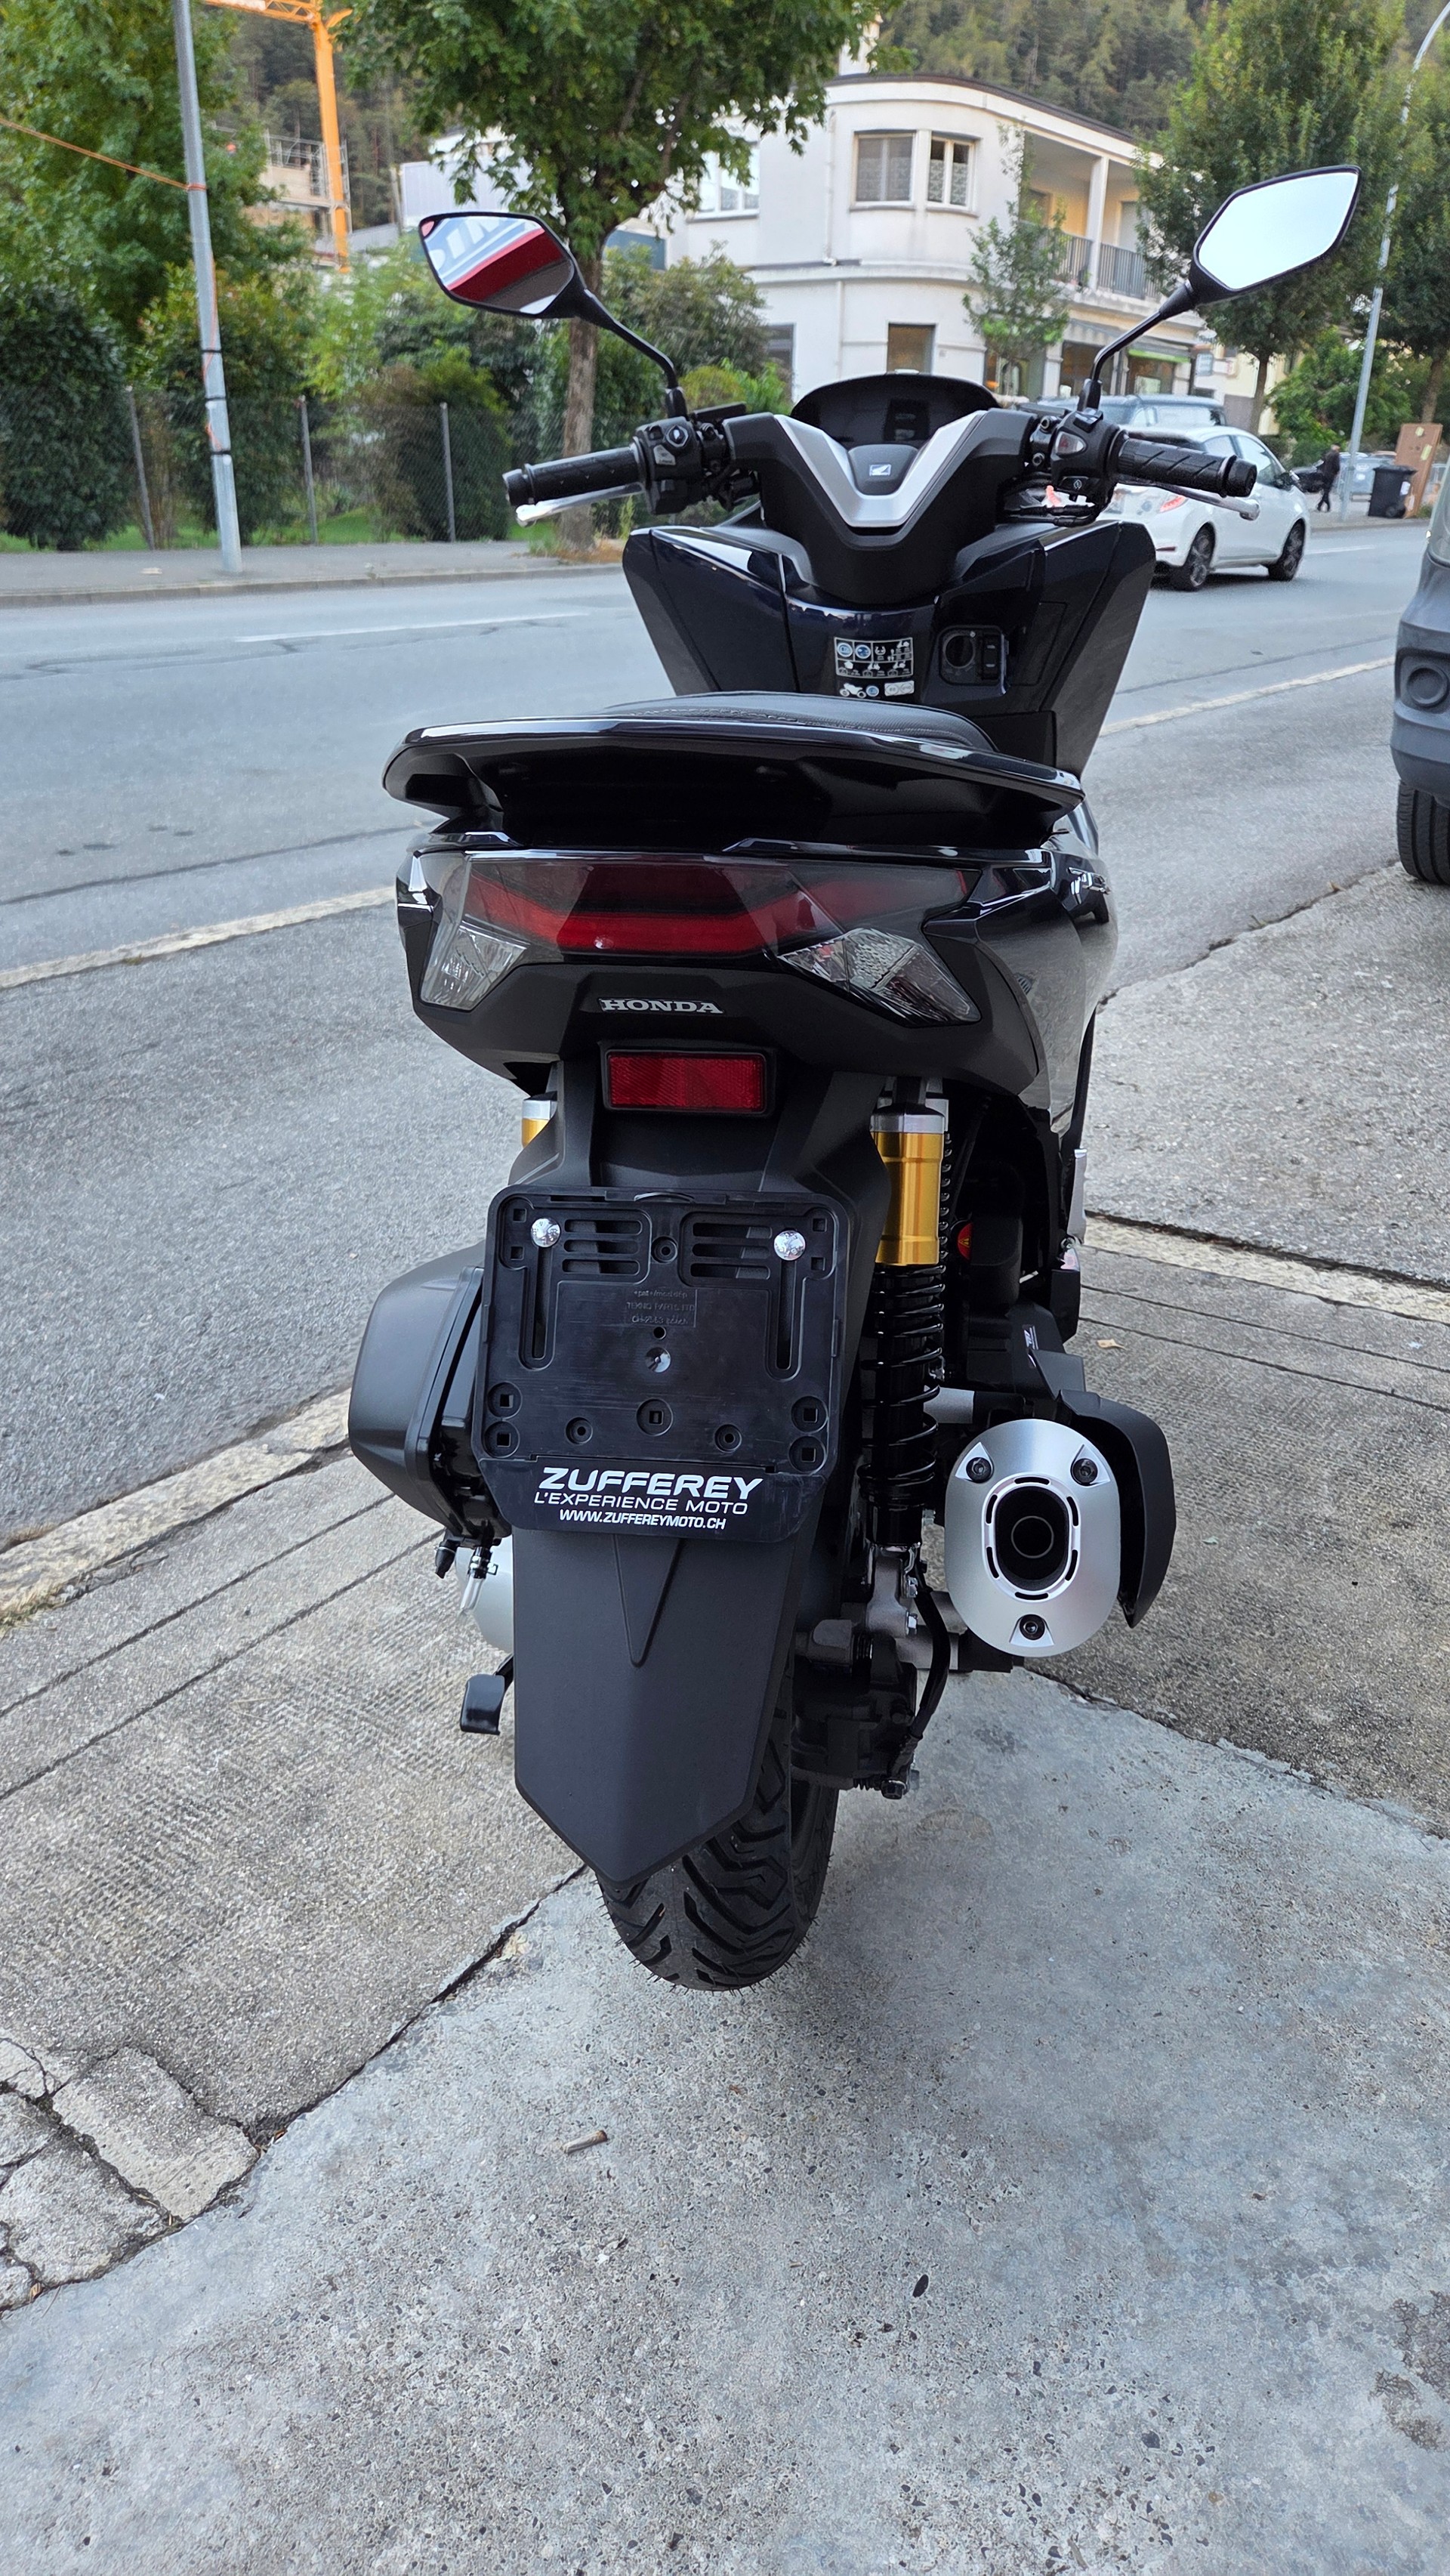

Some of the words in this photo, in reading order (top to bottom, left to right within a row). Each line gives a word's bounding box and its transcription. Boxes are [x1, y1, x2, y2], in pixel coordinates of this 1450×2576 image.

[601, 999, 723, 1014] HONDA
[538, 1467, 764, 1500] ZUFFEREY
[534, 1491, 679, 1511] L'EXPERIENCE
[685, 1500, 748, 1515] MOTO
[560, 1509, 727, 1530] WWW.ZUFFEREYMOTO.CH
